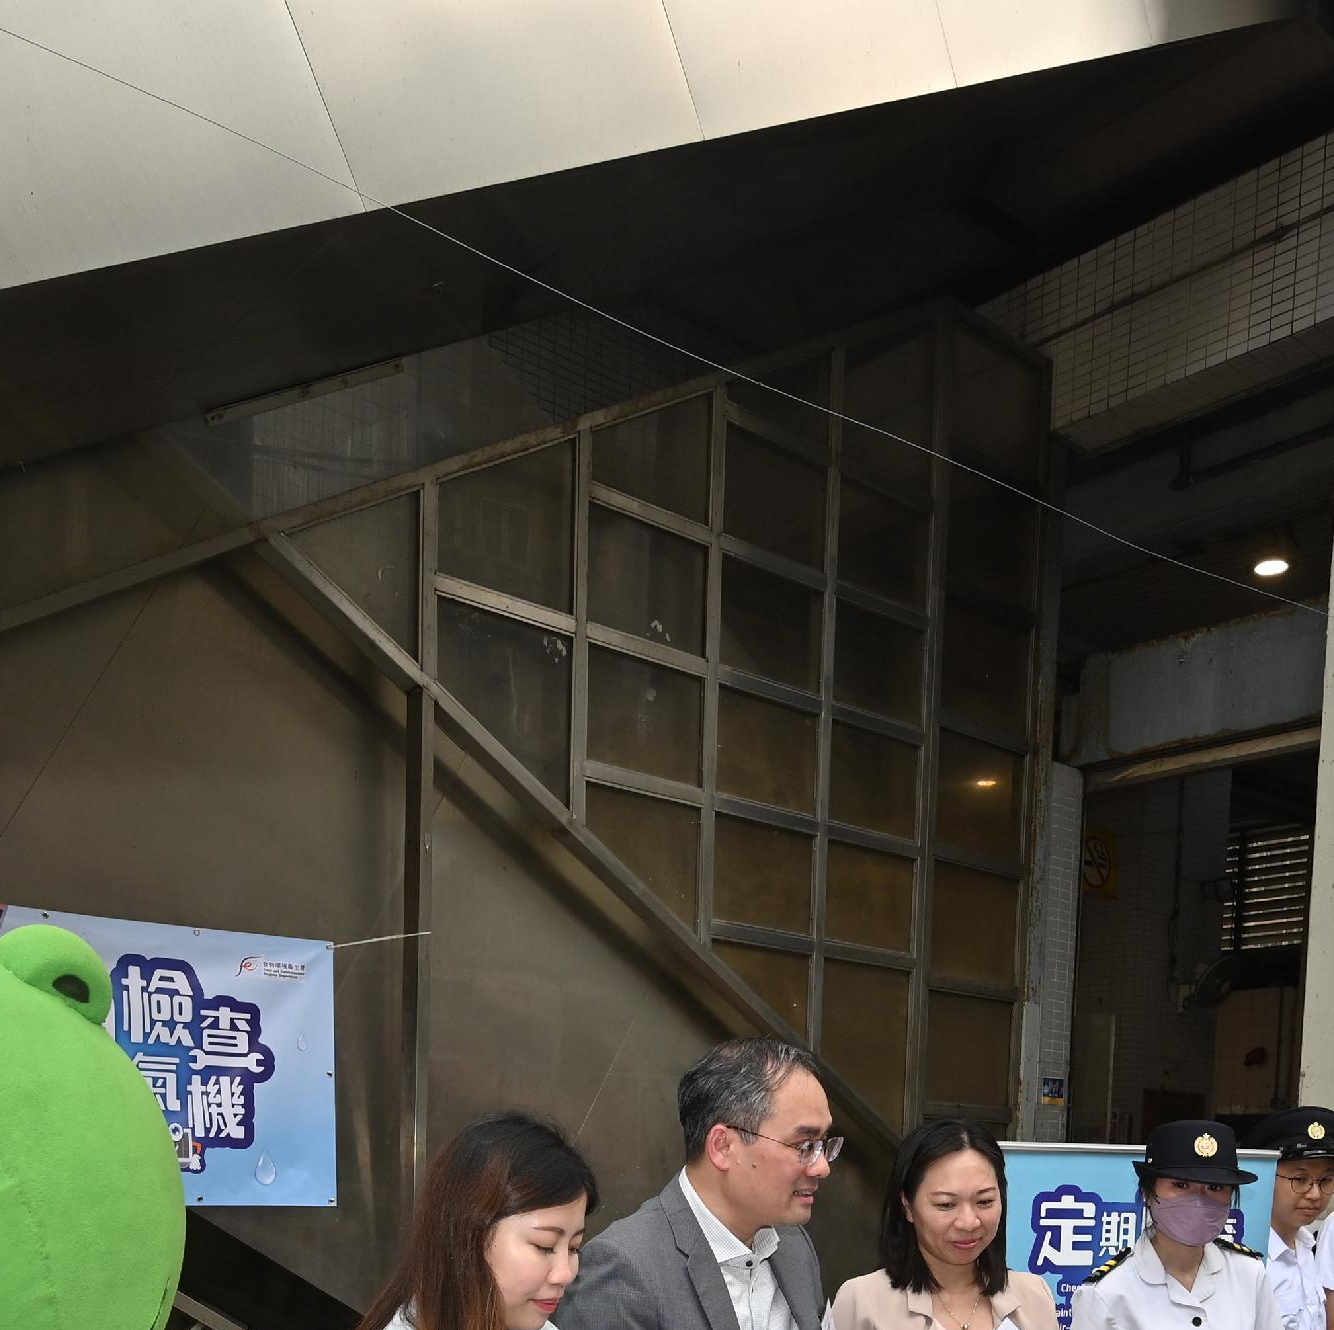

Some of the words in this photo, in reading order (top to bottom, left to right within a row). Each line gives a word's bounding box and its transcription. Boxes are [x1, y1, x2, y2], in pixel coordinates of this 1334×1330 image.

[107, 964, 265, 1075] 檢查
[131, 1053, 246, 1140] 氣機
[1037, 1194, 1137, 1266] 定期
